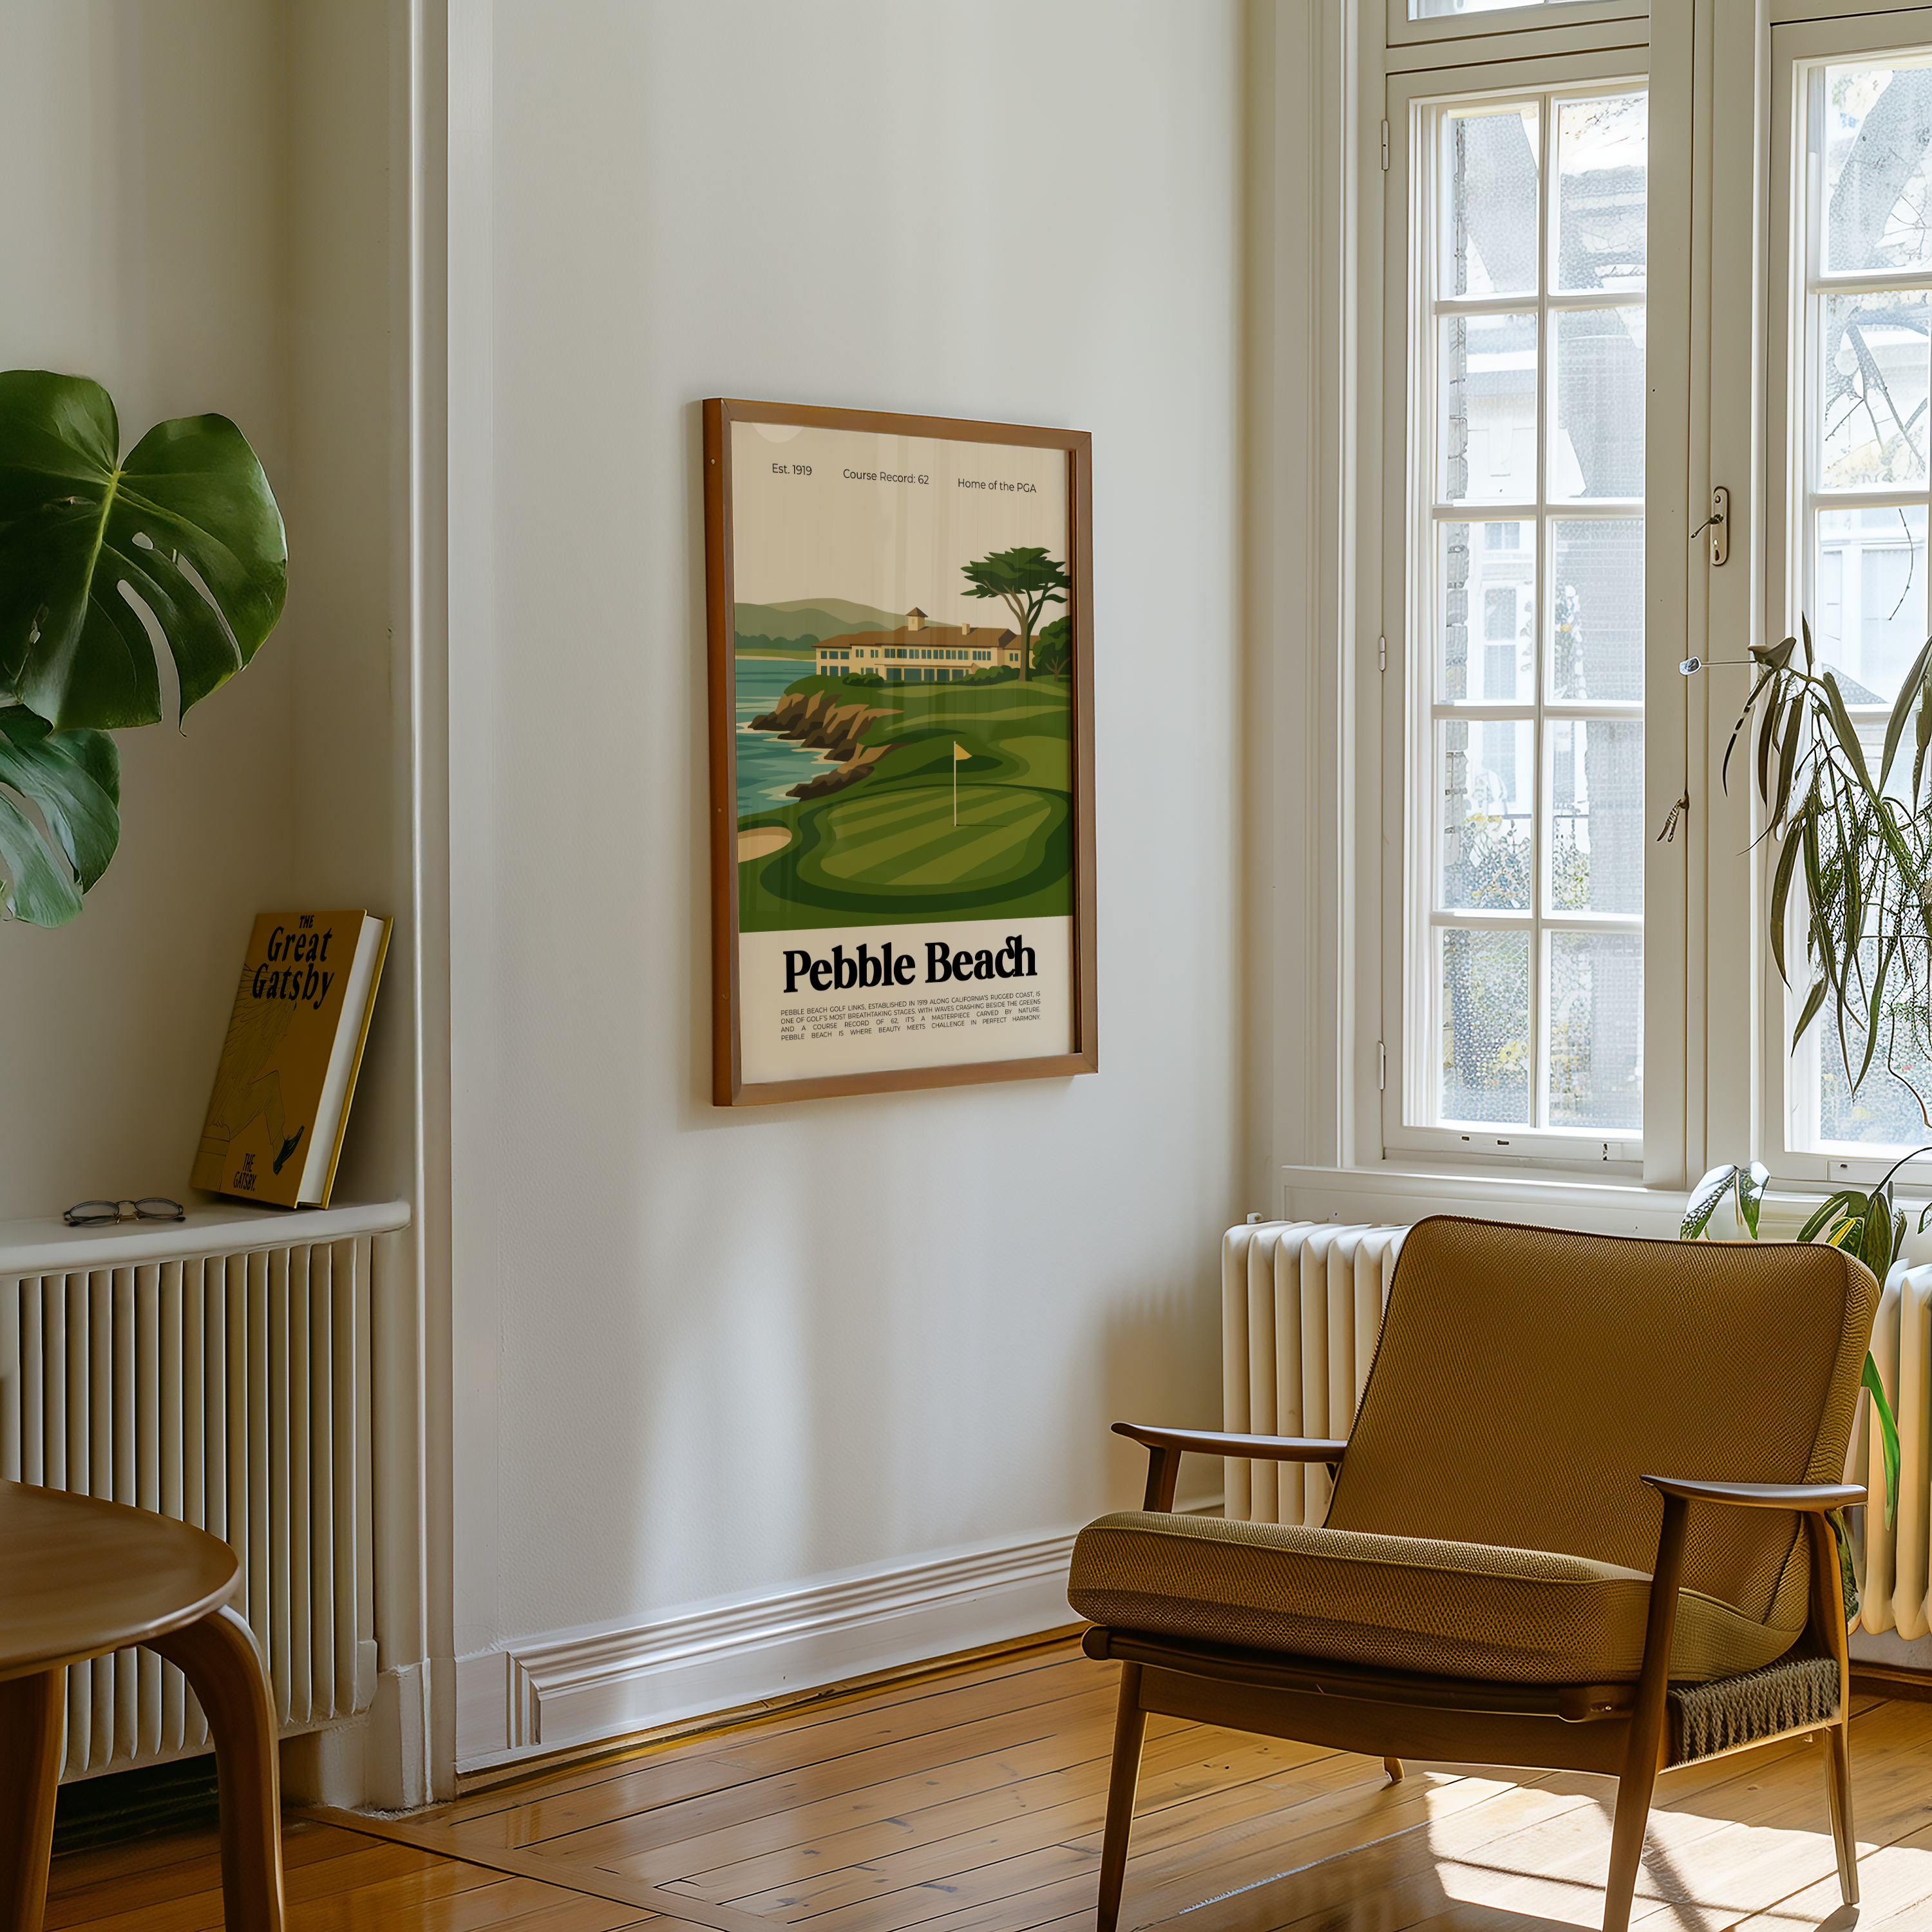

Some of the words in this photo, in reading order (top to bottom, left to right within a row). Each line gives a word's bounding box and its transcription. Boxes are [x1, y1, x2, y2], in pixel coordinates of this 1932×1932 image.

[772, 463, 790, 474] Est.
[792, 464, 813, 476] 1919
[842, 469, 877, 480] Course
[879, 471, 916, 484] Record:
[918, 474, 929, 485] 62
[958, 478, 986, 489] Home
[988, 480, 998, 490] of
[999, 481, 1015, 491] the
[1016, 482, 1037, 493] PGA
[298, 914, 314, 929] THE
[267, 925, 333, 963] Great
[782, 942, 916, 994] Pebble
[924, 934, 1037, 983] Beach
[252, 962, 335, 1010] Gatsby
[868, 1001, 907, 1010] ESTABLISHED
[951, 994, 989, 1003] CALIFORNIA'S
[848, 1010, 892, 1019] BREATHTAKING
[956, 1003, 985, 1011] CRASHING
[844, 1019, 869, 1028] RECORD
[931, 1012, 971, 1021] MASTERPIECE
[781, 1033, 805, 1041] PEBBLE
[931, 1020, 965, 1028] CHALLENGE
[242, 1153, 256, 1173] THE
[233, 1171, 257, 1192] GATSBY.
